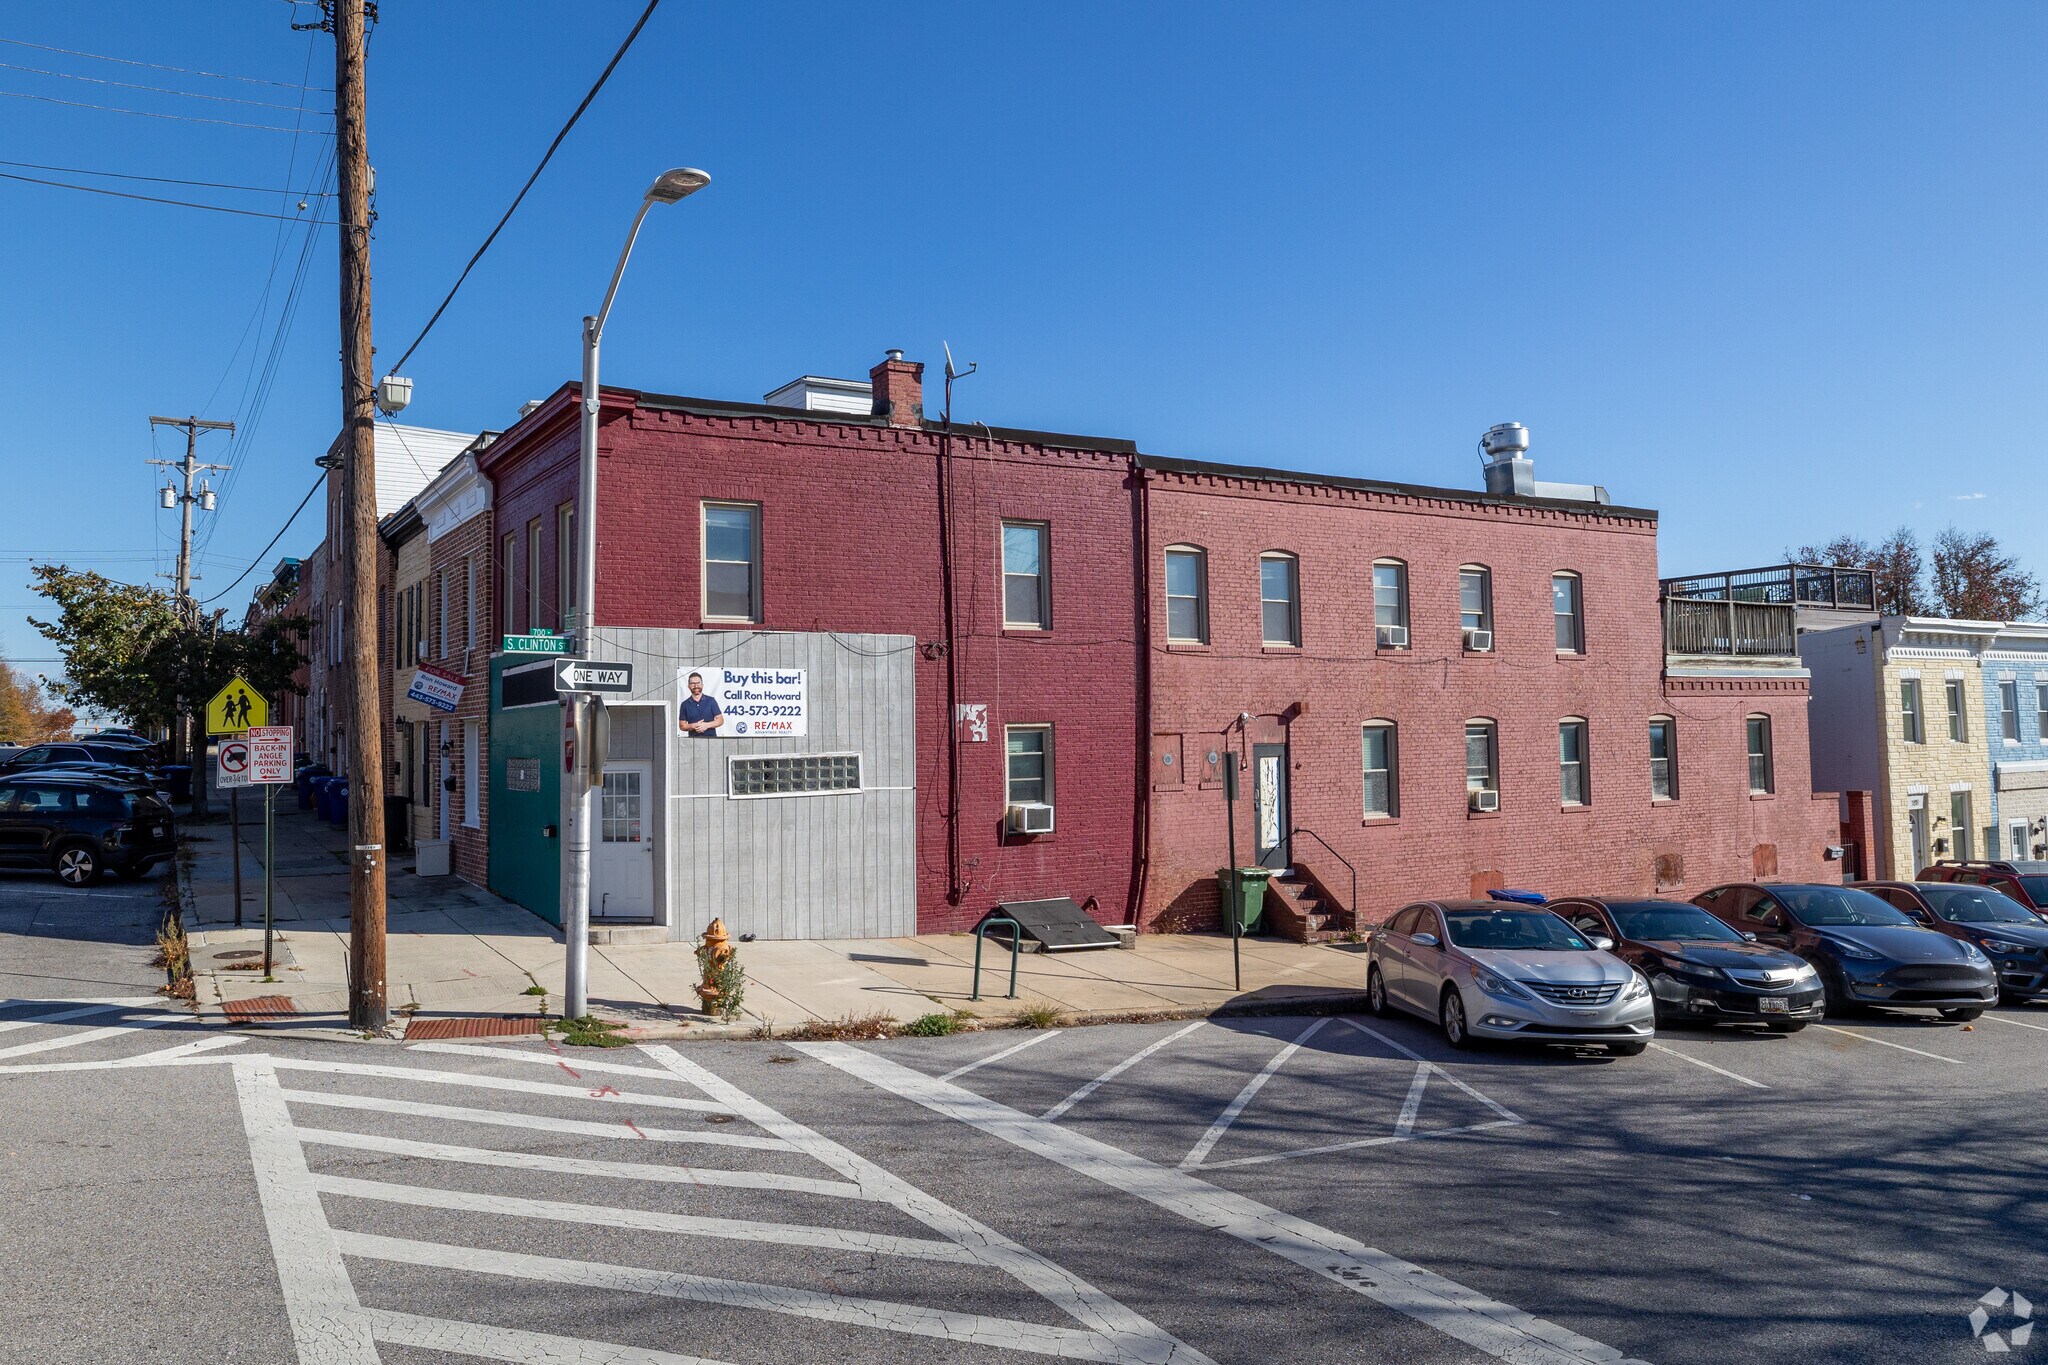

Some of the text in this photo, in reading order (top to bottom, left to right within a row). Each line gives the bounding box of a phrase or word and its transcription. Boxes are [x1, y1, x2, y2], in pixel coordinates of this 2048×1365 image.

[507, 638, 515, 649] S.
[518, 639, 556, 650] CLINTON
[425, 666, 460, 683] FOR SALE
[573, 670, 623, 683] ONE WAY
[724, 671, 801, 687] Buy this bar!
[421, 674, 458, 691] Ron Howard
[427, 685, 457, 700] RE/MAX
[724, 690, 801, 701] Call Ron Howard
[410, 691, 453, 711] 443-573-9222
[723, 705, 801, 716] 443-573-9222
[754, 721, 793, 730] RE/MAX
[250, 729, 290, 737] NO STOPPING
[219, 776, 232, 784] OVER
